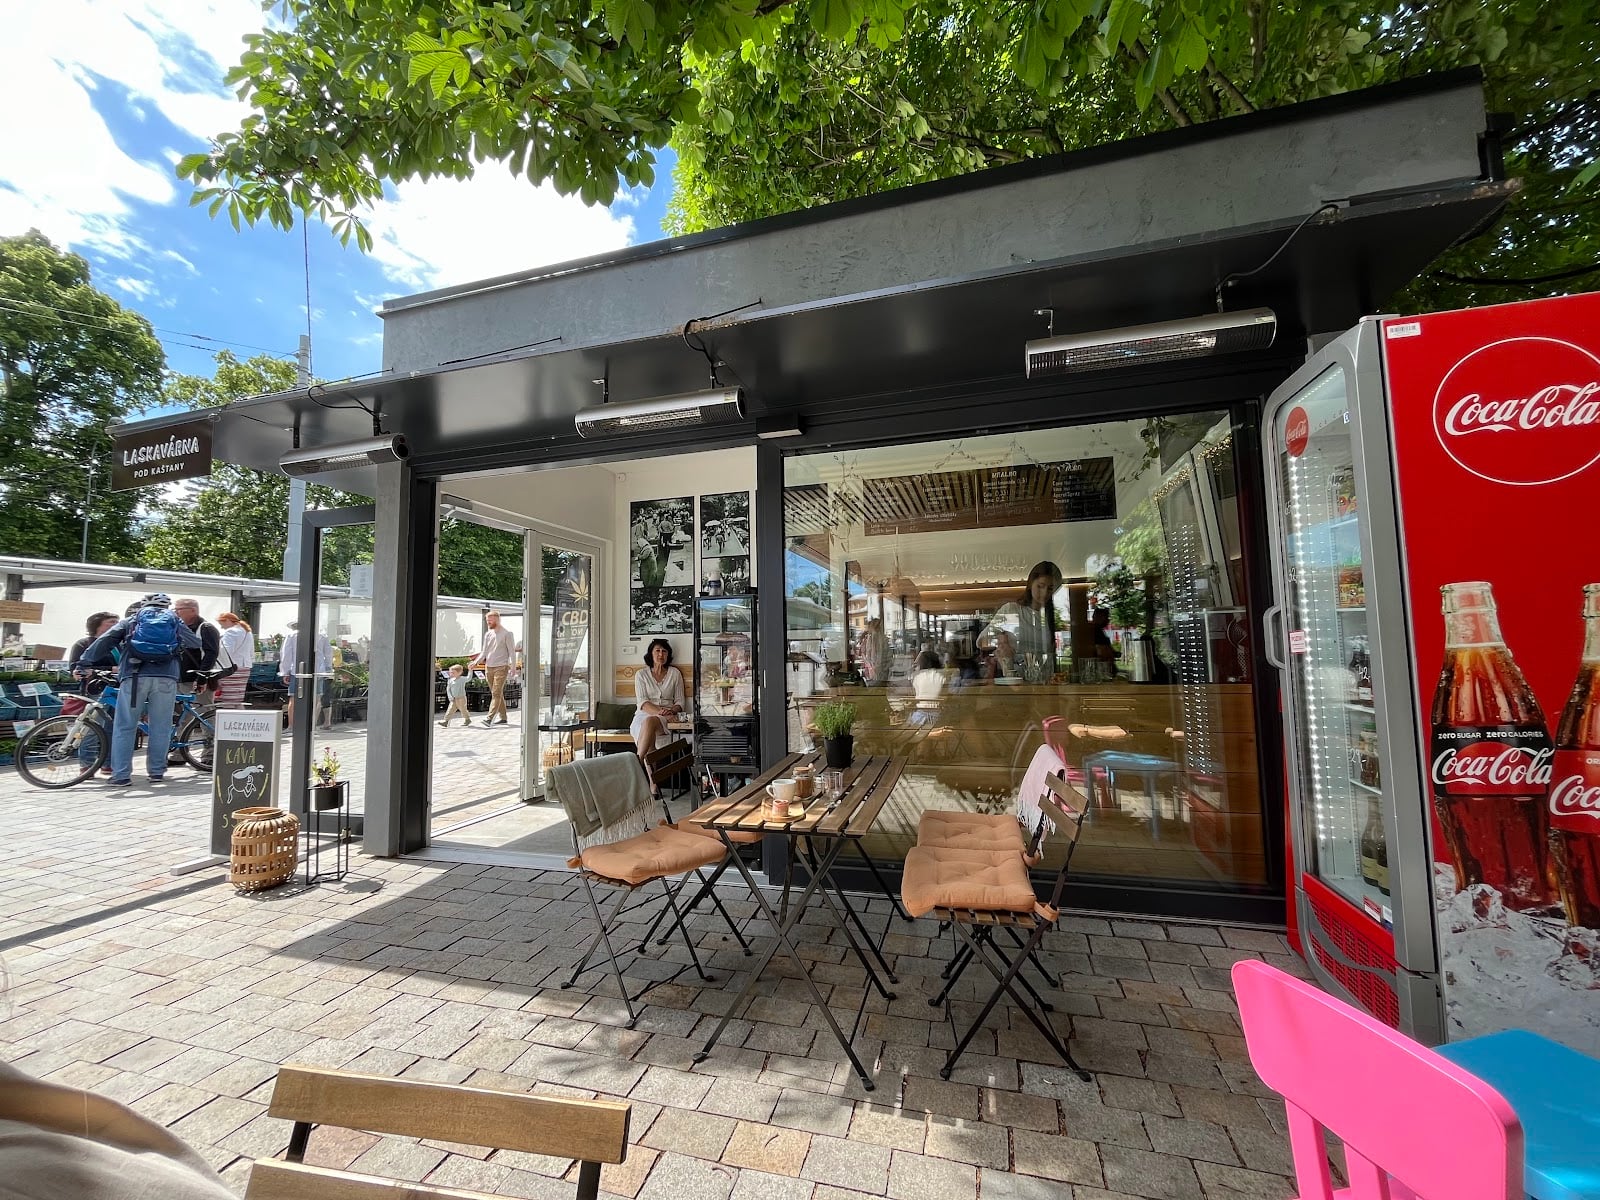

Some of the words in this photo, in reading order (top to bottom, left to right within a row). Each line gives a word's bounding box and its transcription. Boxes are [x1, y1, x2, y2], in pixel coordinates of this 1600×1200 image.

[1445, 382, 1600, 436] Coca-Cola
[123, 435, 199, 466] LASKAVÁRNA
[134, 469, 149, 479] POD
[151, 462, 185, 476] KAŠTANY
[561, 609, 589, 626] CBD
[225, 742, 256, 765] KÁVA
[1432, 747, 1555, 785] Coca-Cola
